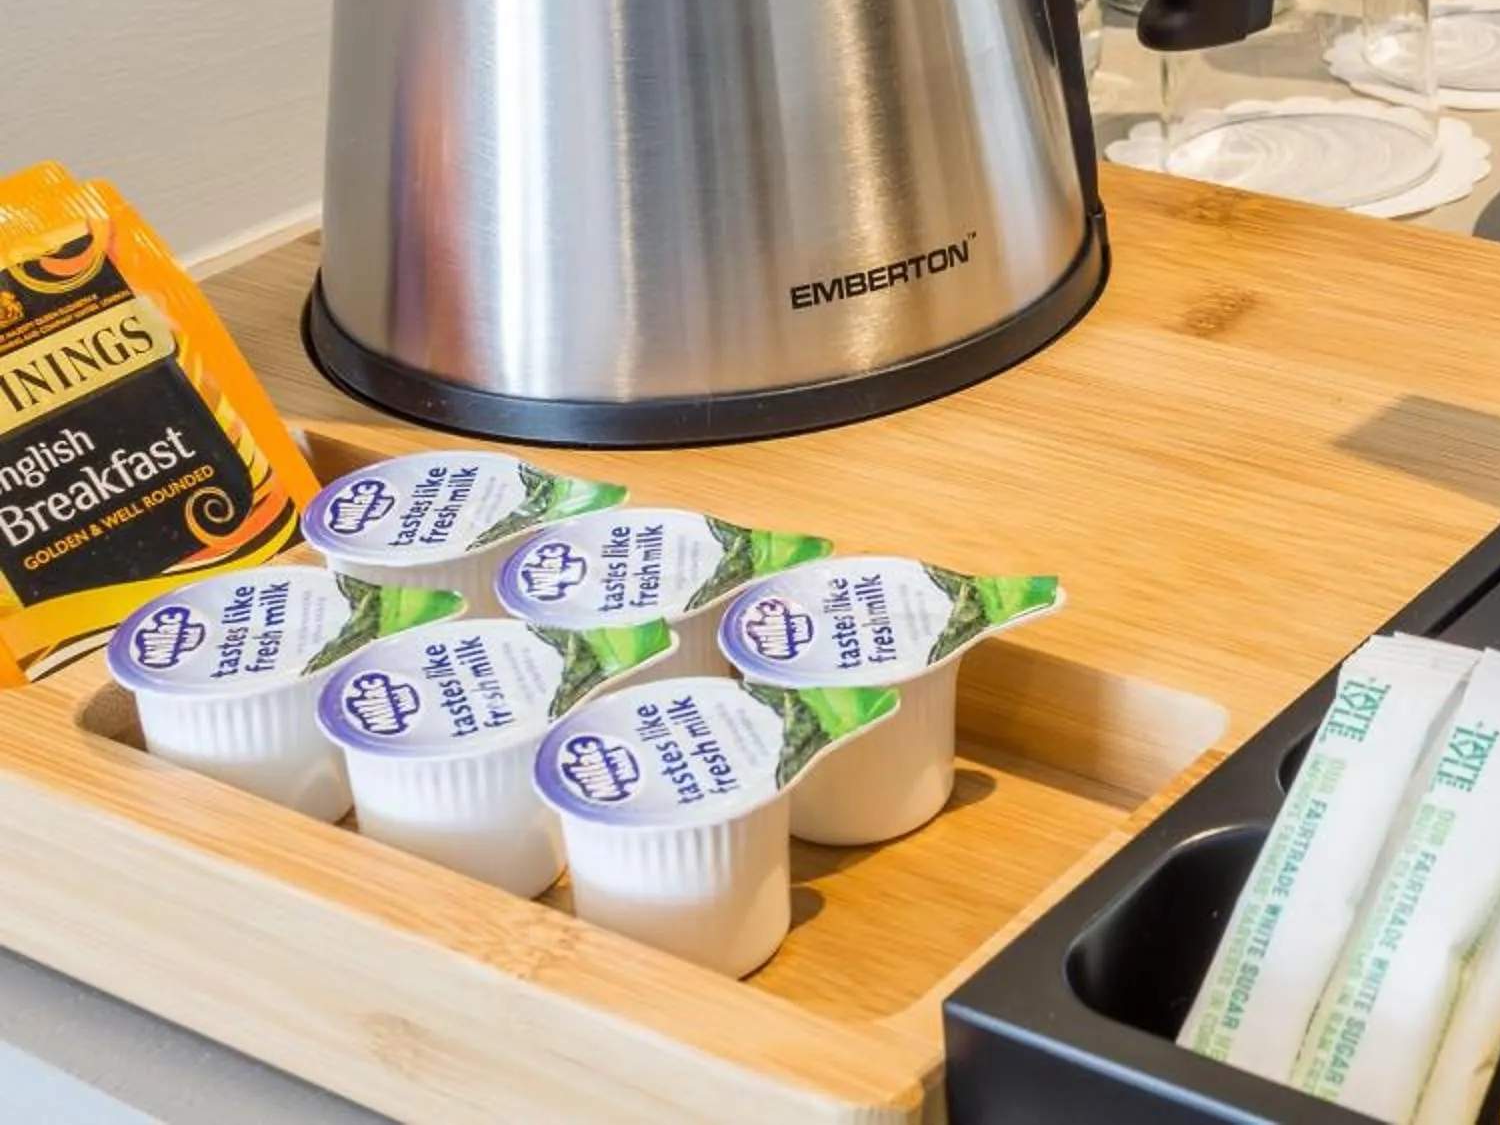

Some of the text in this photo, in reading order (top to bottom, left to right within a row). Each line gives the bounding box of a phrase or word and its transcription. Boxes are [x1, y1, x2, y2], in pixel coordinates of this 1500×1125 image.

[0, 428, 96, 495] nglish
[0, 426, 196, 548] Breakfast
[23, 464, 215, 571] GOLDEN & WELL ROUNDED
[388, 467, 447, 546] tastes like
[419, 466, 479, 543] fresh milk
[598, 526, 630, 611] tastes like
[629, 525, 663, 607] fresh milk
[209, 586, 255, 677] tastes like
[245, 581, 290, 672] fresh milk
[453, 636, 494, 678] milk
[823, 578, 862, 668] tastes like
[854, 574, 897, 662] fresh milk
[422, 643, 479, 737] tastes like
[1343, 685, 1391, 741] TATE
[635, 704, 704, 804] tastes like
[666, 695, 740, 794] fresh milk
[1453, 732, 1500, 791] TATE
[1271, 796, 1328, 899] FAIRTRADE
[1246, 900, 1284, 960] WHITE
[1379, 848, 1437, 951] FAIRTRADE
[1218, 960, 1261, 1031] SUGAR
[1352, 953, 1391, 1014] WHITE
[1322, 1014, 1367, 1086] SUGAR
